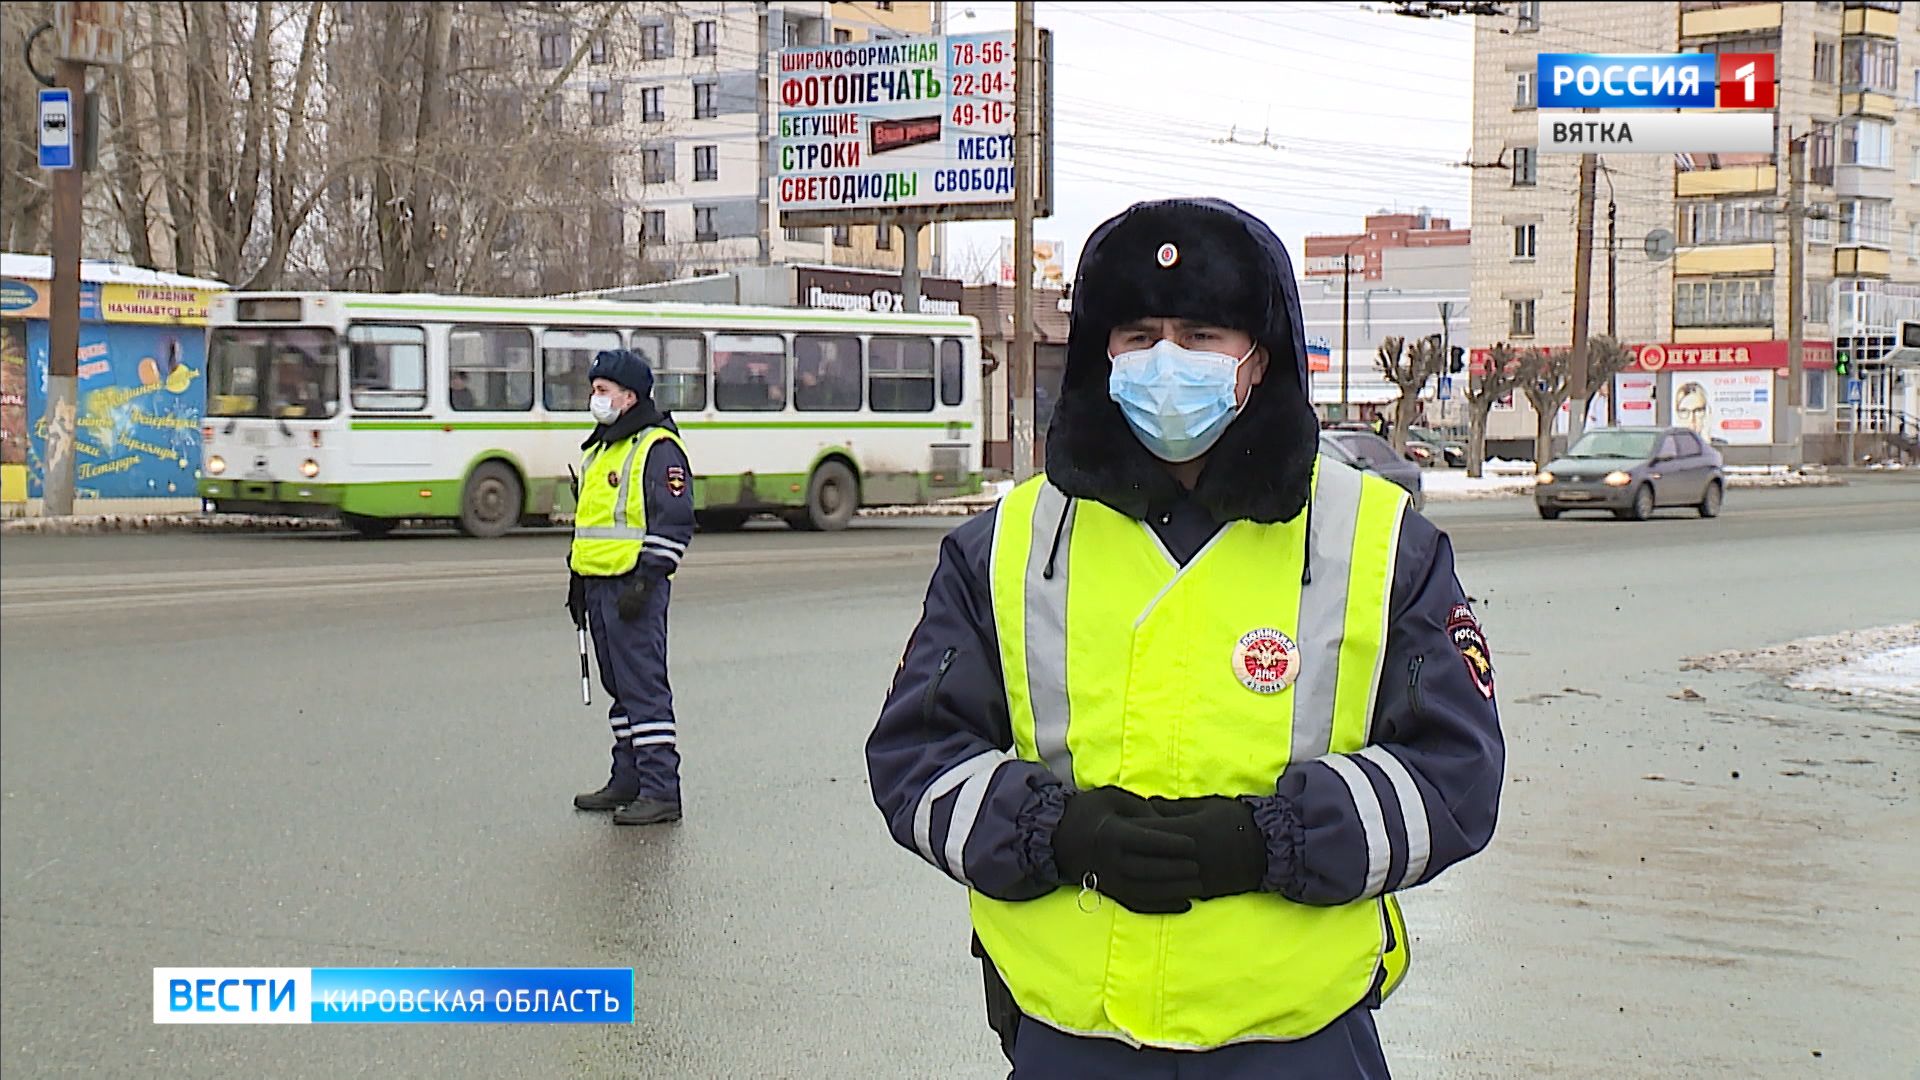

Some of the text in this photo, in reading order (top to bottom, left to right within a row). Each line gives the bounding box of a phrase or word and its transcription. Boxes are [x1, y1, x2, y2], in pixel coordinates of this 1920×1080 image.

[782, 42, 938, 72] ШИРОКОФОРМАТНАЯ
[782, 68, 941, 107] ФОТОПЕЧАТЬ
[782, 113, 858, 138] БЕГУЩИЕ
[783, 142, 860, 170] СТРОКИ
[782, 172, 917, 203] СВЕТОДИОДЫ
[137, 289, 195, 302] ПРАЗДНИК
[809, 287, 871, 310] Пекарня
[108, 303, 181, 316] НАЧИНАЕТСЯ
